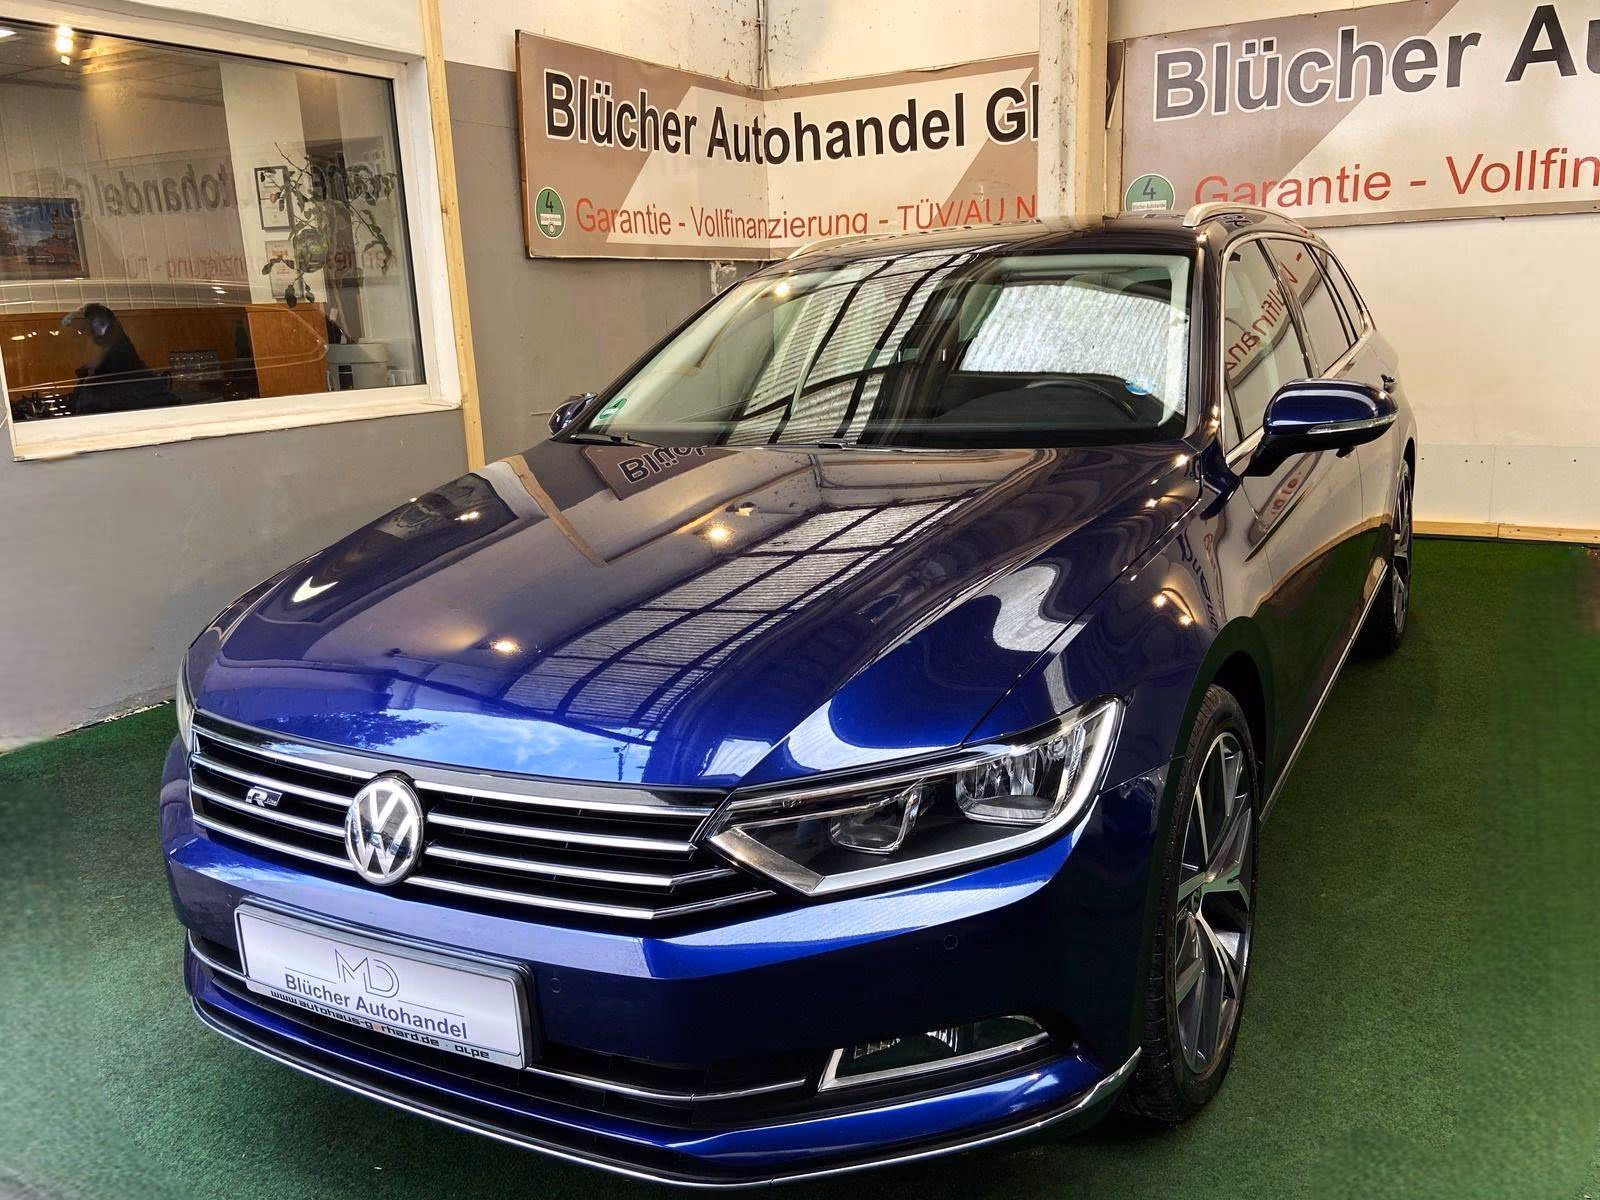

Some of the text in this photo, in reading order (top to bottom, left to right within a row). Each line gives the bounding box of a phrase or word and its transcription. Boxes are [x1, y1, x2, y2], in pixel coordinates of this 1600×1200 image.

[1154, 28, 1482, 121] Blücher
[544, 70, 698, 156] Blücher
[706, 92, 965, 165] Autohandel
[545, 191, 555, 213] 4
[1142, 177, 1157, 200] 4
[1194, 163, 1392, 208] Garantie
[1445, 147, 1600, 195] Vollfin
[575, 197, 671, 235] Garantie
[690, 203, 868, 240] Vollfinanzierung
[896, 198, 1005, 231] TÜV/AU
[270, 989, 440, 1047] www.autohaus-grhard.de
[285, 973, 467, 1040] Blücher Autohandel
